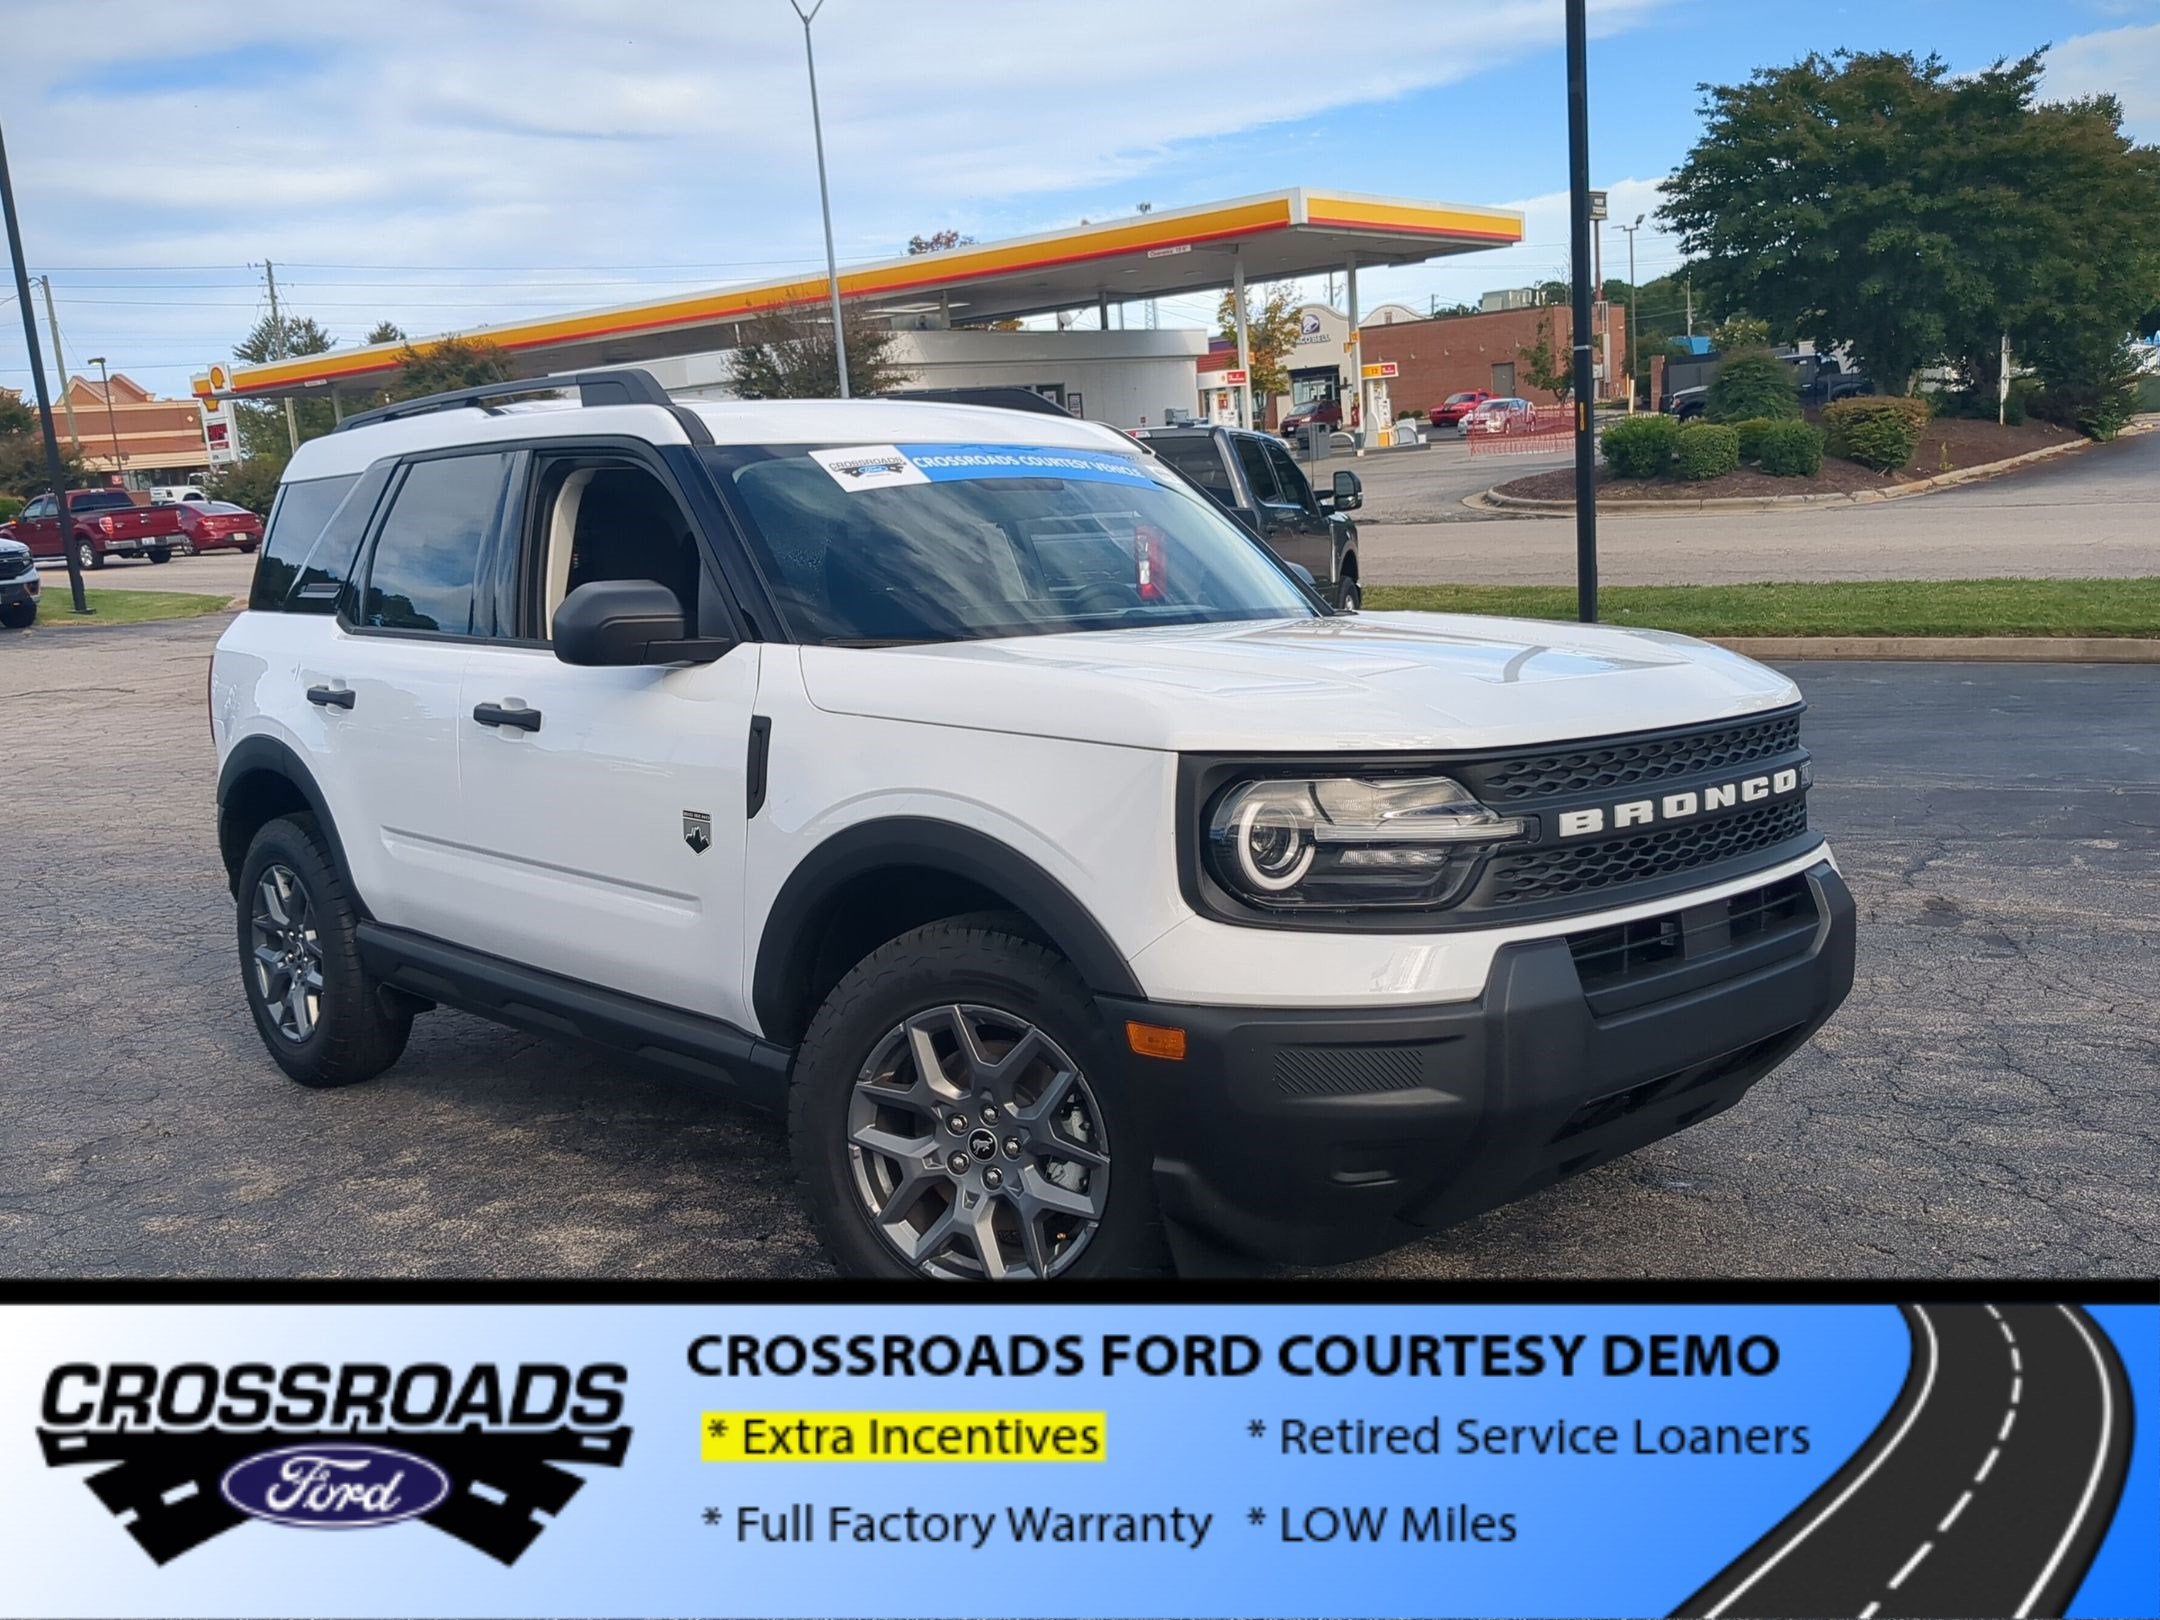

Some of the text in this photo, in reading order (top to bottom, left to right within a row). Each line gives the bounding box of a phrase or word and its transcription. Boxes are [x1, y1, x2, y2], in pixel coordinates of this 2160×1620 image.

[828, 456, 905, 472] CROSSROADS
[912, 455, 1020, 468] CROSSROADS
[1019, 455, 1094, 471] COURTESY
[1090, 461, 1147, 479] VEHICLE
[1558, 768, 1797, 838] BRONCO
